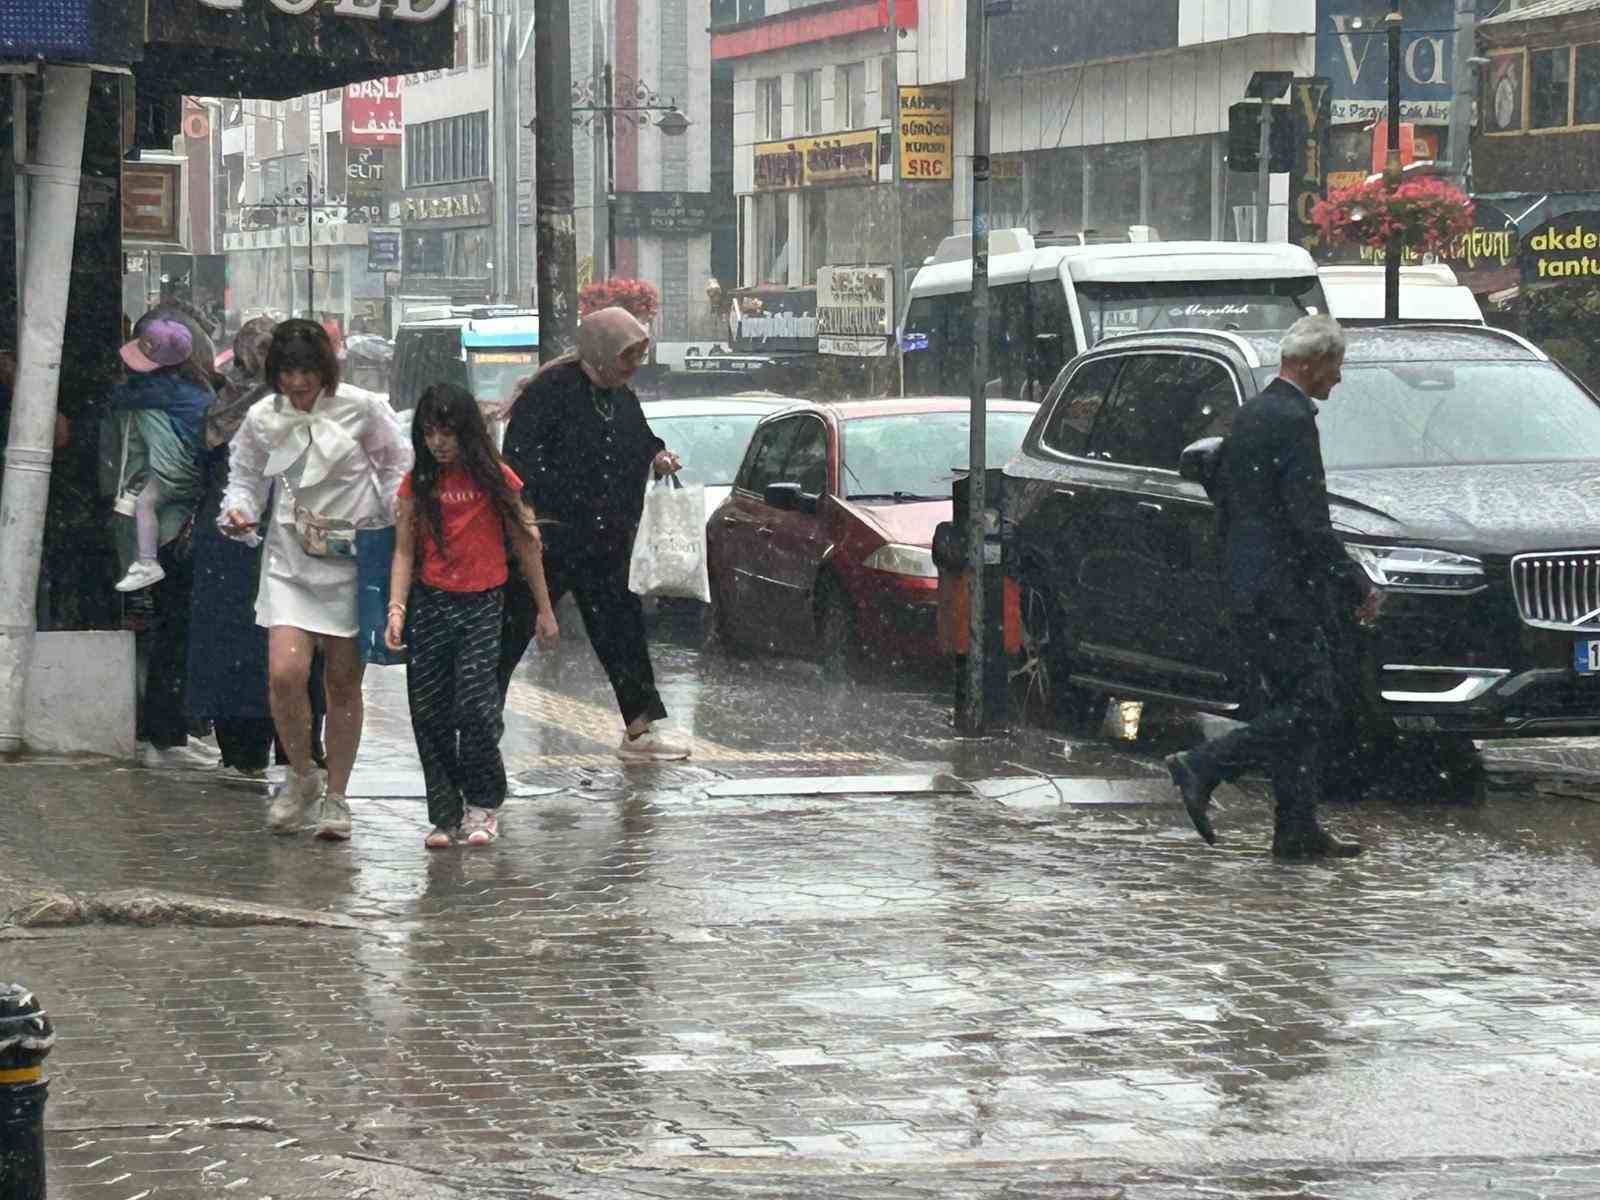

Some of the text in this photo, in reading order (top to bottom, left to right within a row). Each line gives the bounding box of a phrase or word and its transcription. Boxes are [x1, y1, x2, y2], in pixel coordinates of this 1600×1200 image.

[1329, 15, 1447, 85] Va
[907, 159, 943, 176] SRC
[1530, 225, 1600, 251] akde
